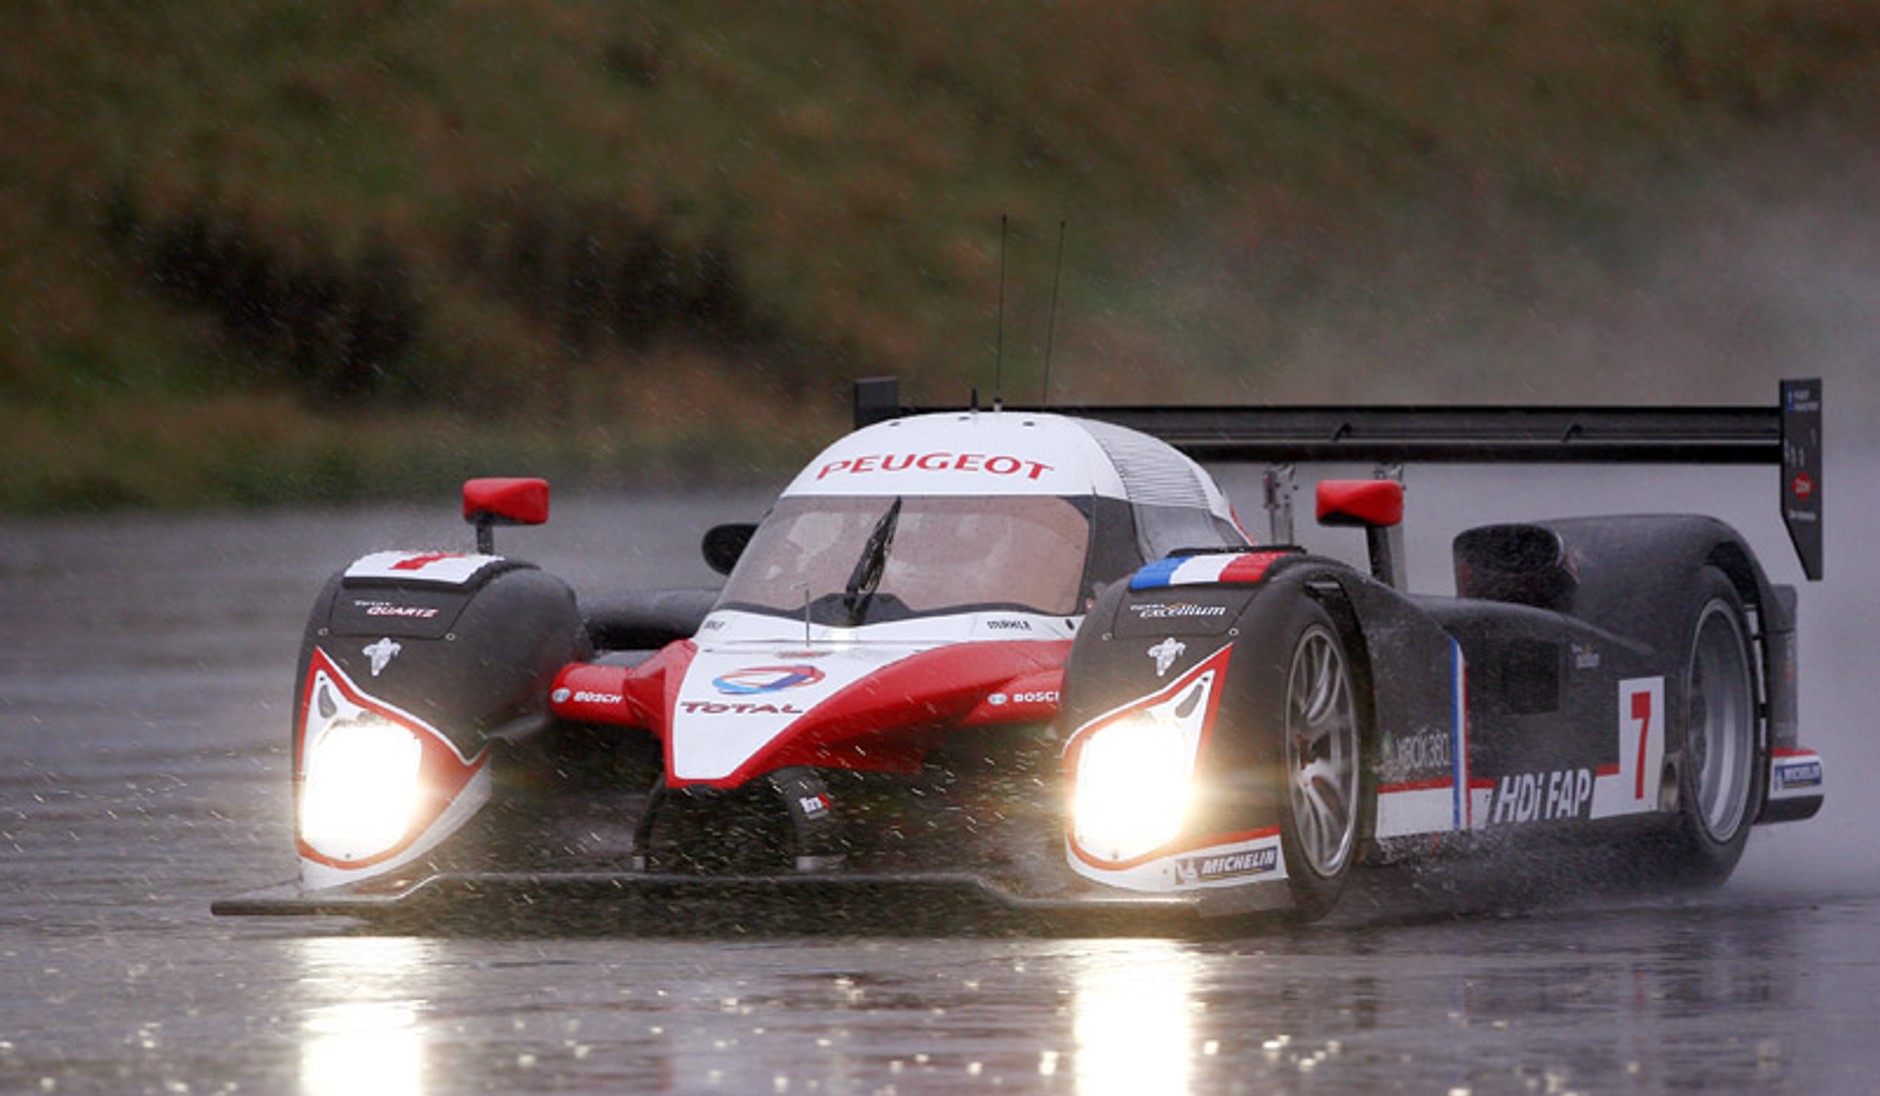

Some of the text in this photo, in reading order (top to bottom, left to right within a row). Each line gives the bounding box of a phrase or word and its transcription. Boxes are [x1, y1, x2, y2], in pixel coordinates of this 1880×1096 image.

[817, 453, 1054, 480] PEUGEOT
[366, 606, 439, 617] QUARTZ
[681, 701, 803, 714] TOTAL
[1631, 691, 1651, 800] 7
[1494, 768, 1591, 824] HDi FAP
[1201, 849, 1276, 874] MICHELIN
